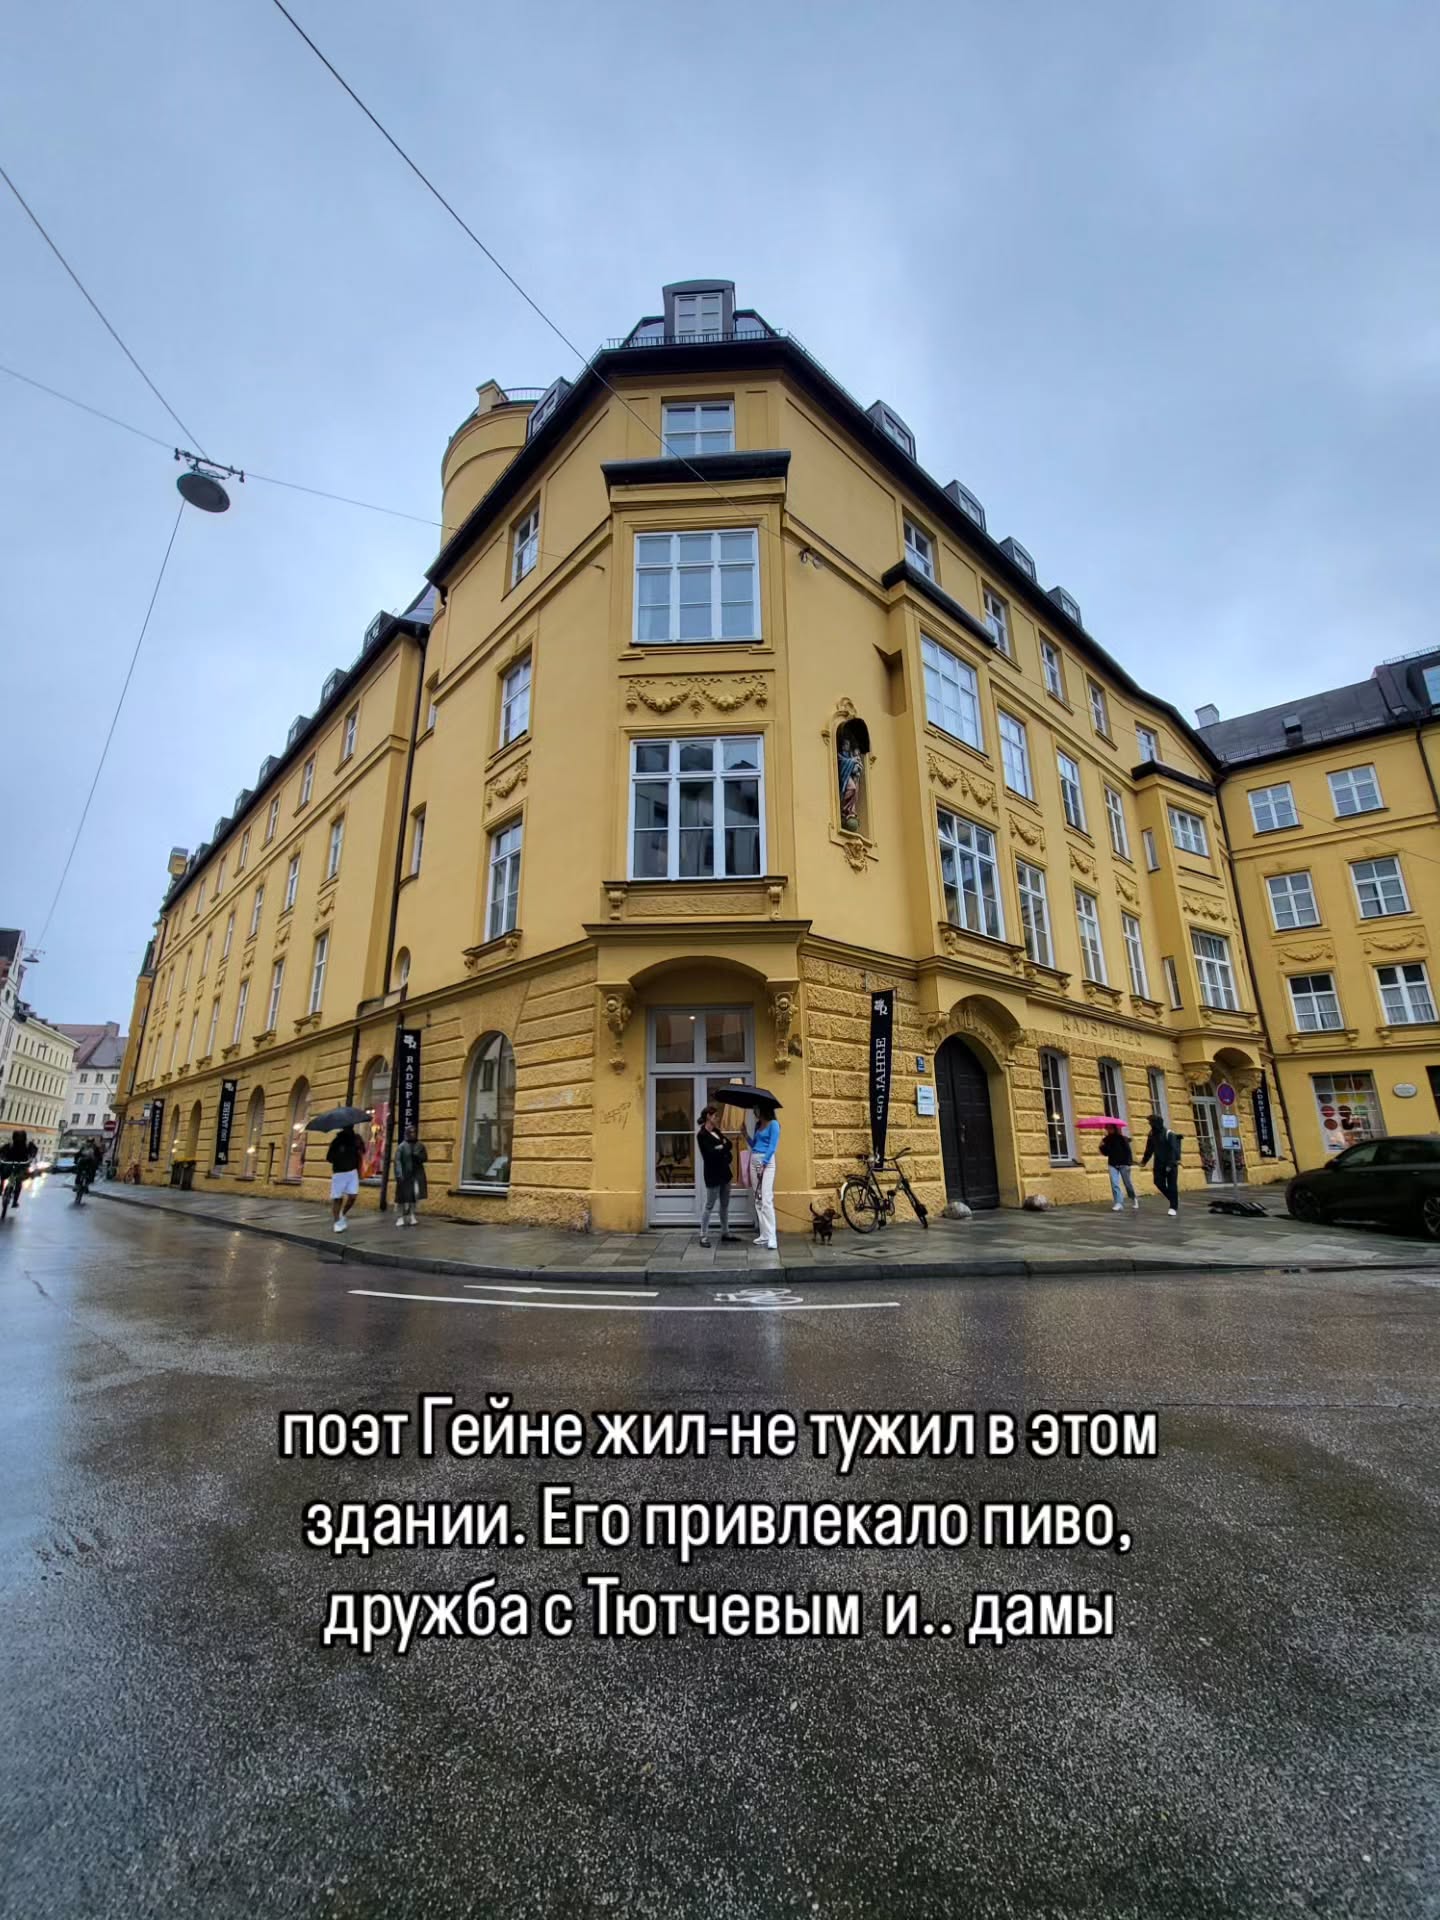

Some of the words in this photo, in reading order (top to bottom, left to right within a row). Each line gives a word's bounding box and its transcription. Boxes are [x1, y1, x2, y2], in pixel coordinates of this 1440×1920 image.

[404, 1055, 414, 1129] RADSPIEL
[876, 1037, 887, 1092] JAHRE
[1256, 1088, 1269, 1141] ADSPIELER
